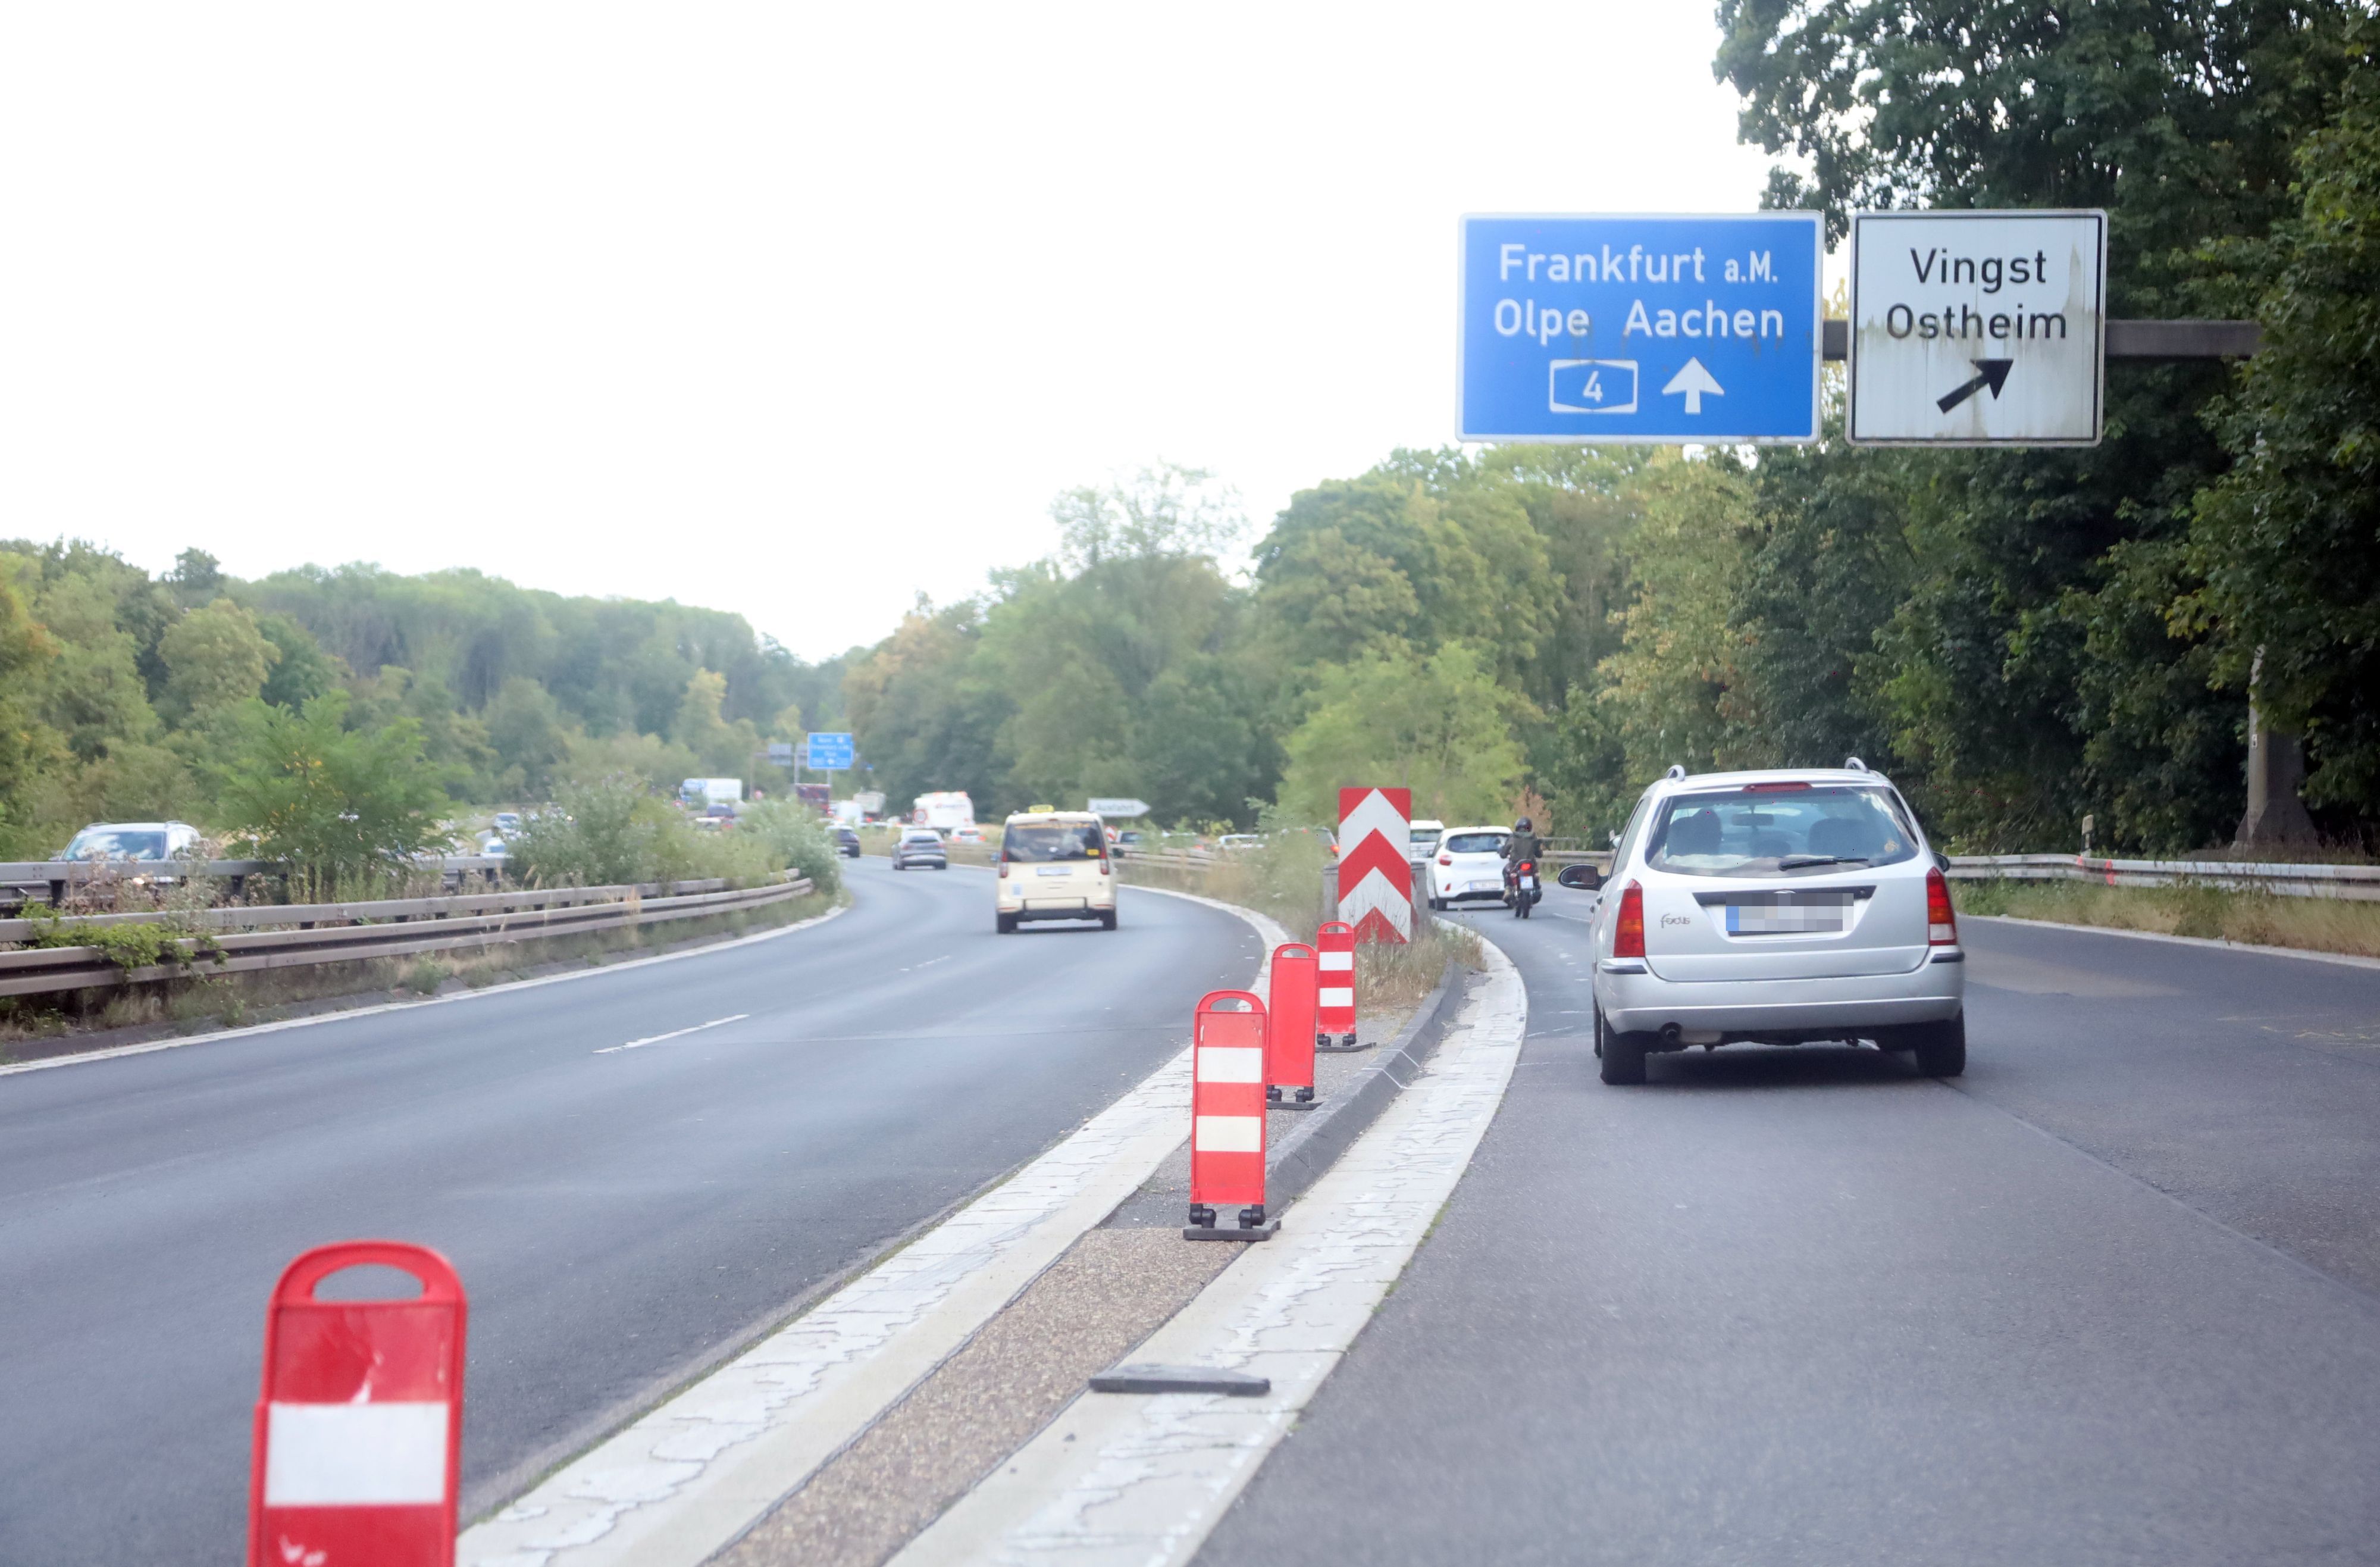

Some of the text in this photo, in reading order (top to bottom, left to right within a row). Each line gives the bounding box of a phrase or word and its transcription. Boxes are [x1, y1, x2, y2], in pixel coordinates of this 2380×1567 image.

[1500, 244, 1778, 283] Frankfurt a.M.
[1910, 247, 2047, 293] Vingst
[1494, 298, 1783, 346] Olpe Aachen
[1886, 302, 2066, 339] Ostheim
[1583, 370, 1604, 403] 4
